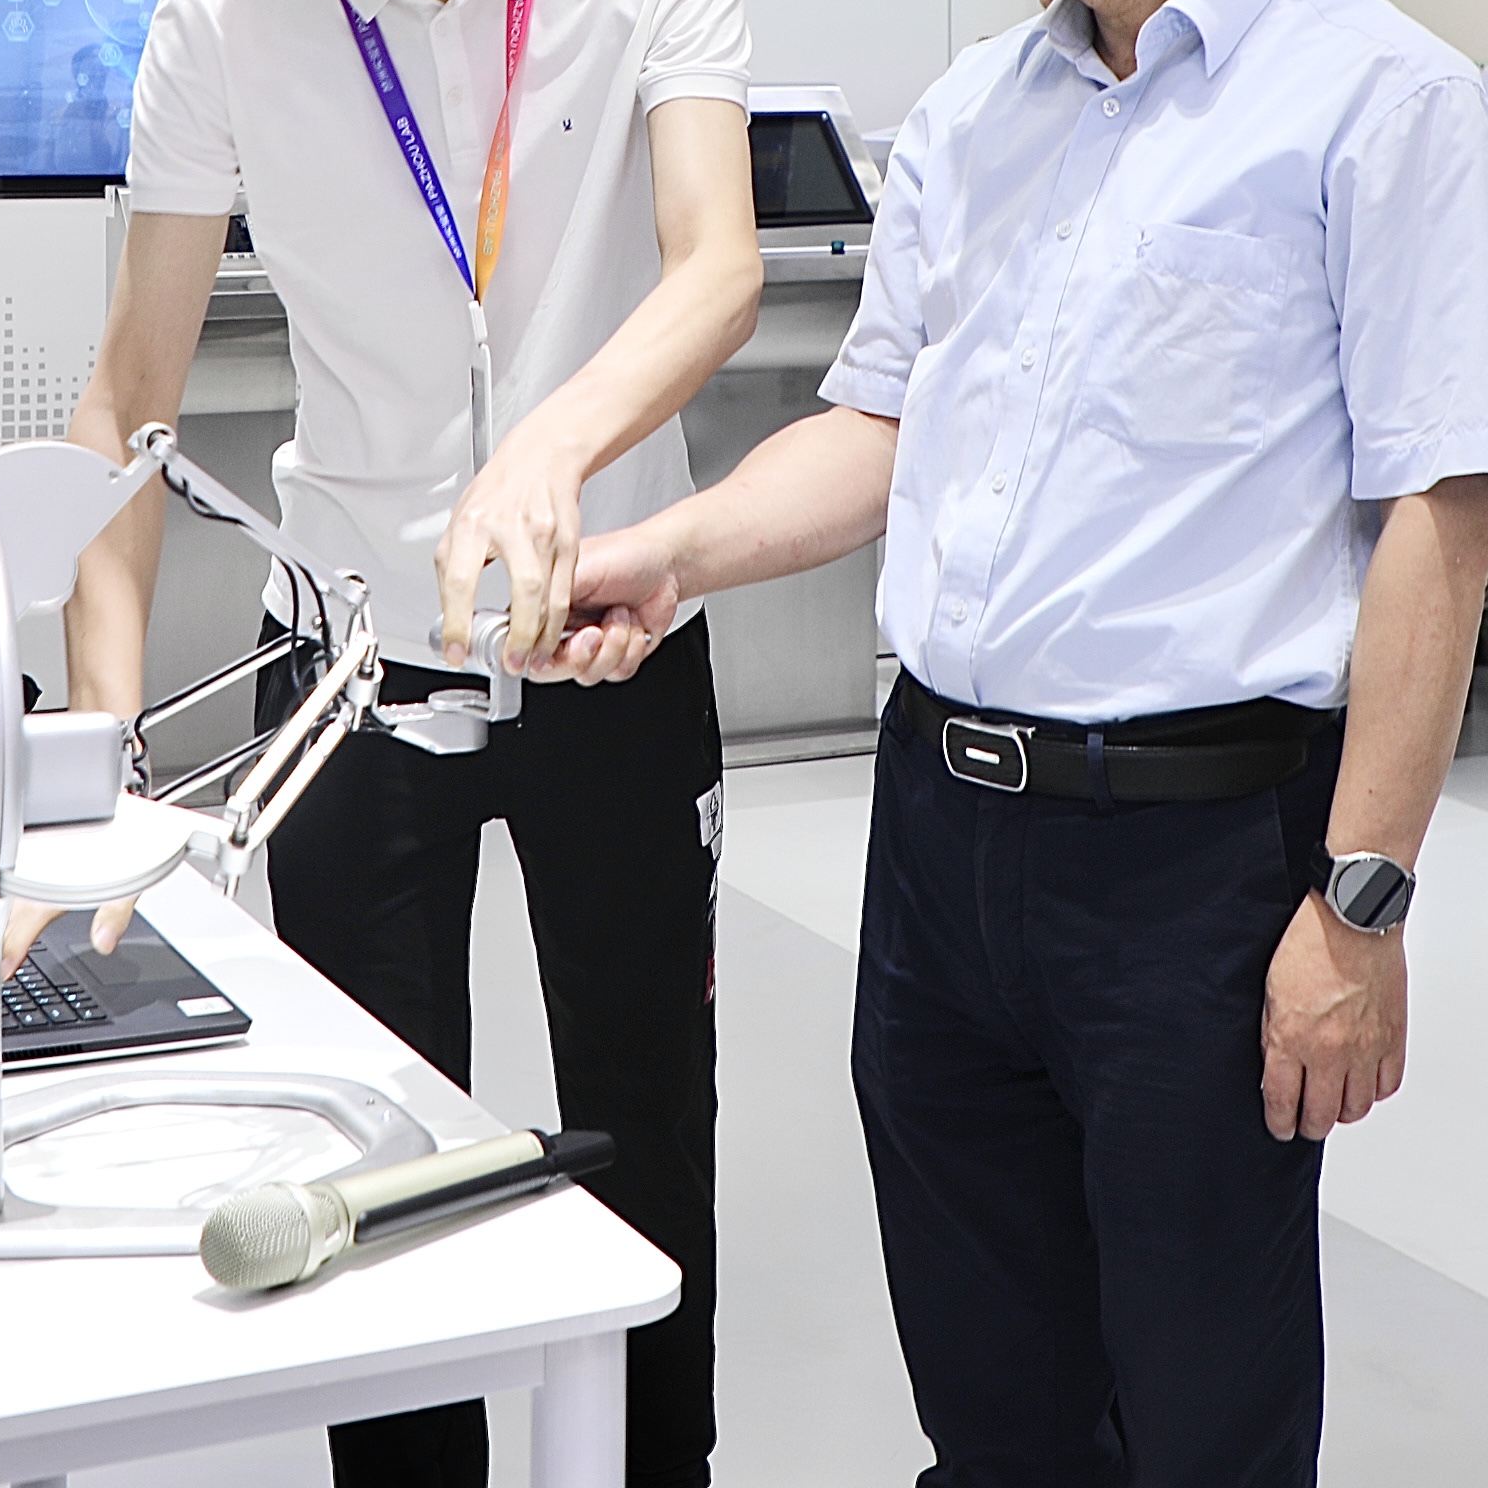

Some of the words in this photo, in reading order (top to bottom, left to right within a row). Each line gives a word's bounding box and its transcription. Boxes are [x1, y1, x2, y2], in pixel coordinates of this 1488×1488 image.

[510, 0, 524, 48] AZHOU
[397, 116, 415, 146] LAB
[408, 144, 438, 201] PAZHOU
[486, 169, 502, 226] PAZHOU
[483, 227, 495, 256] LAB
